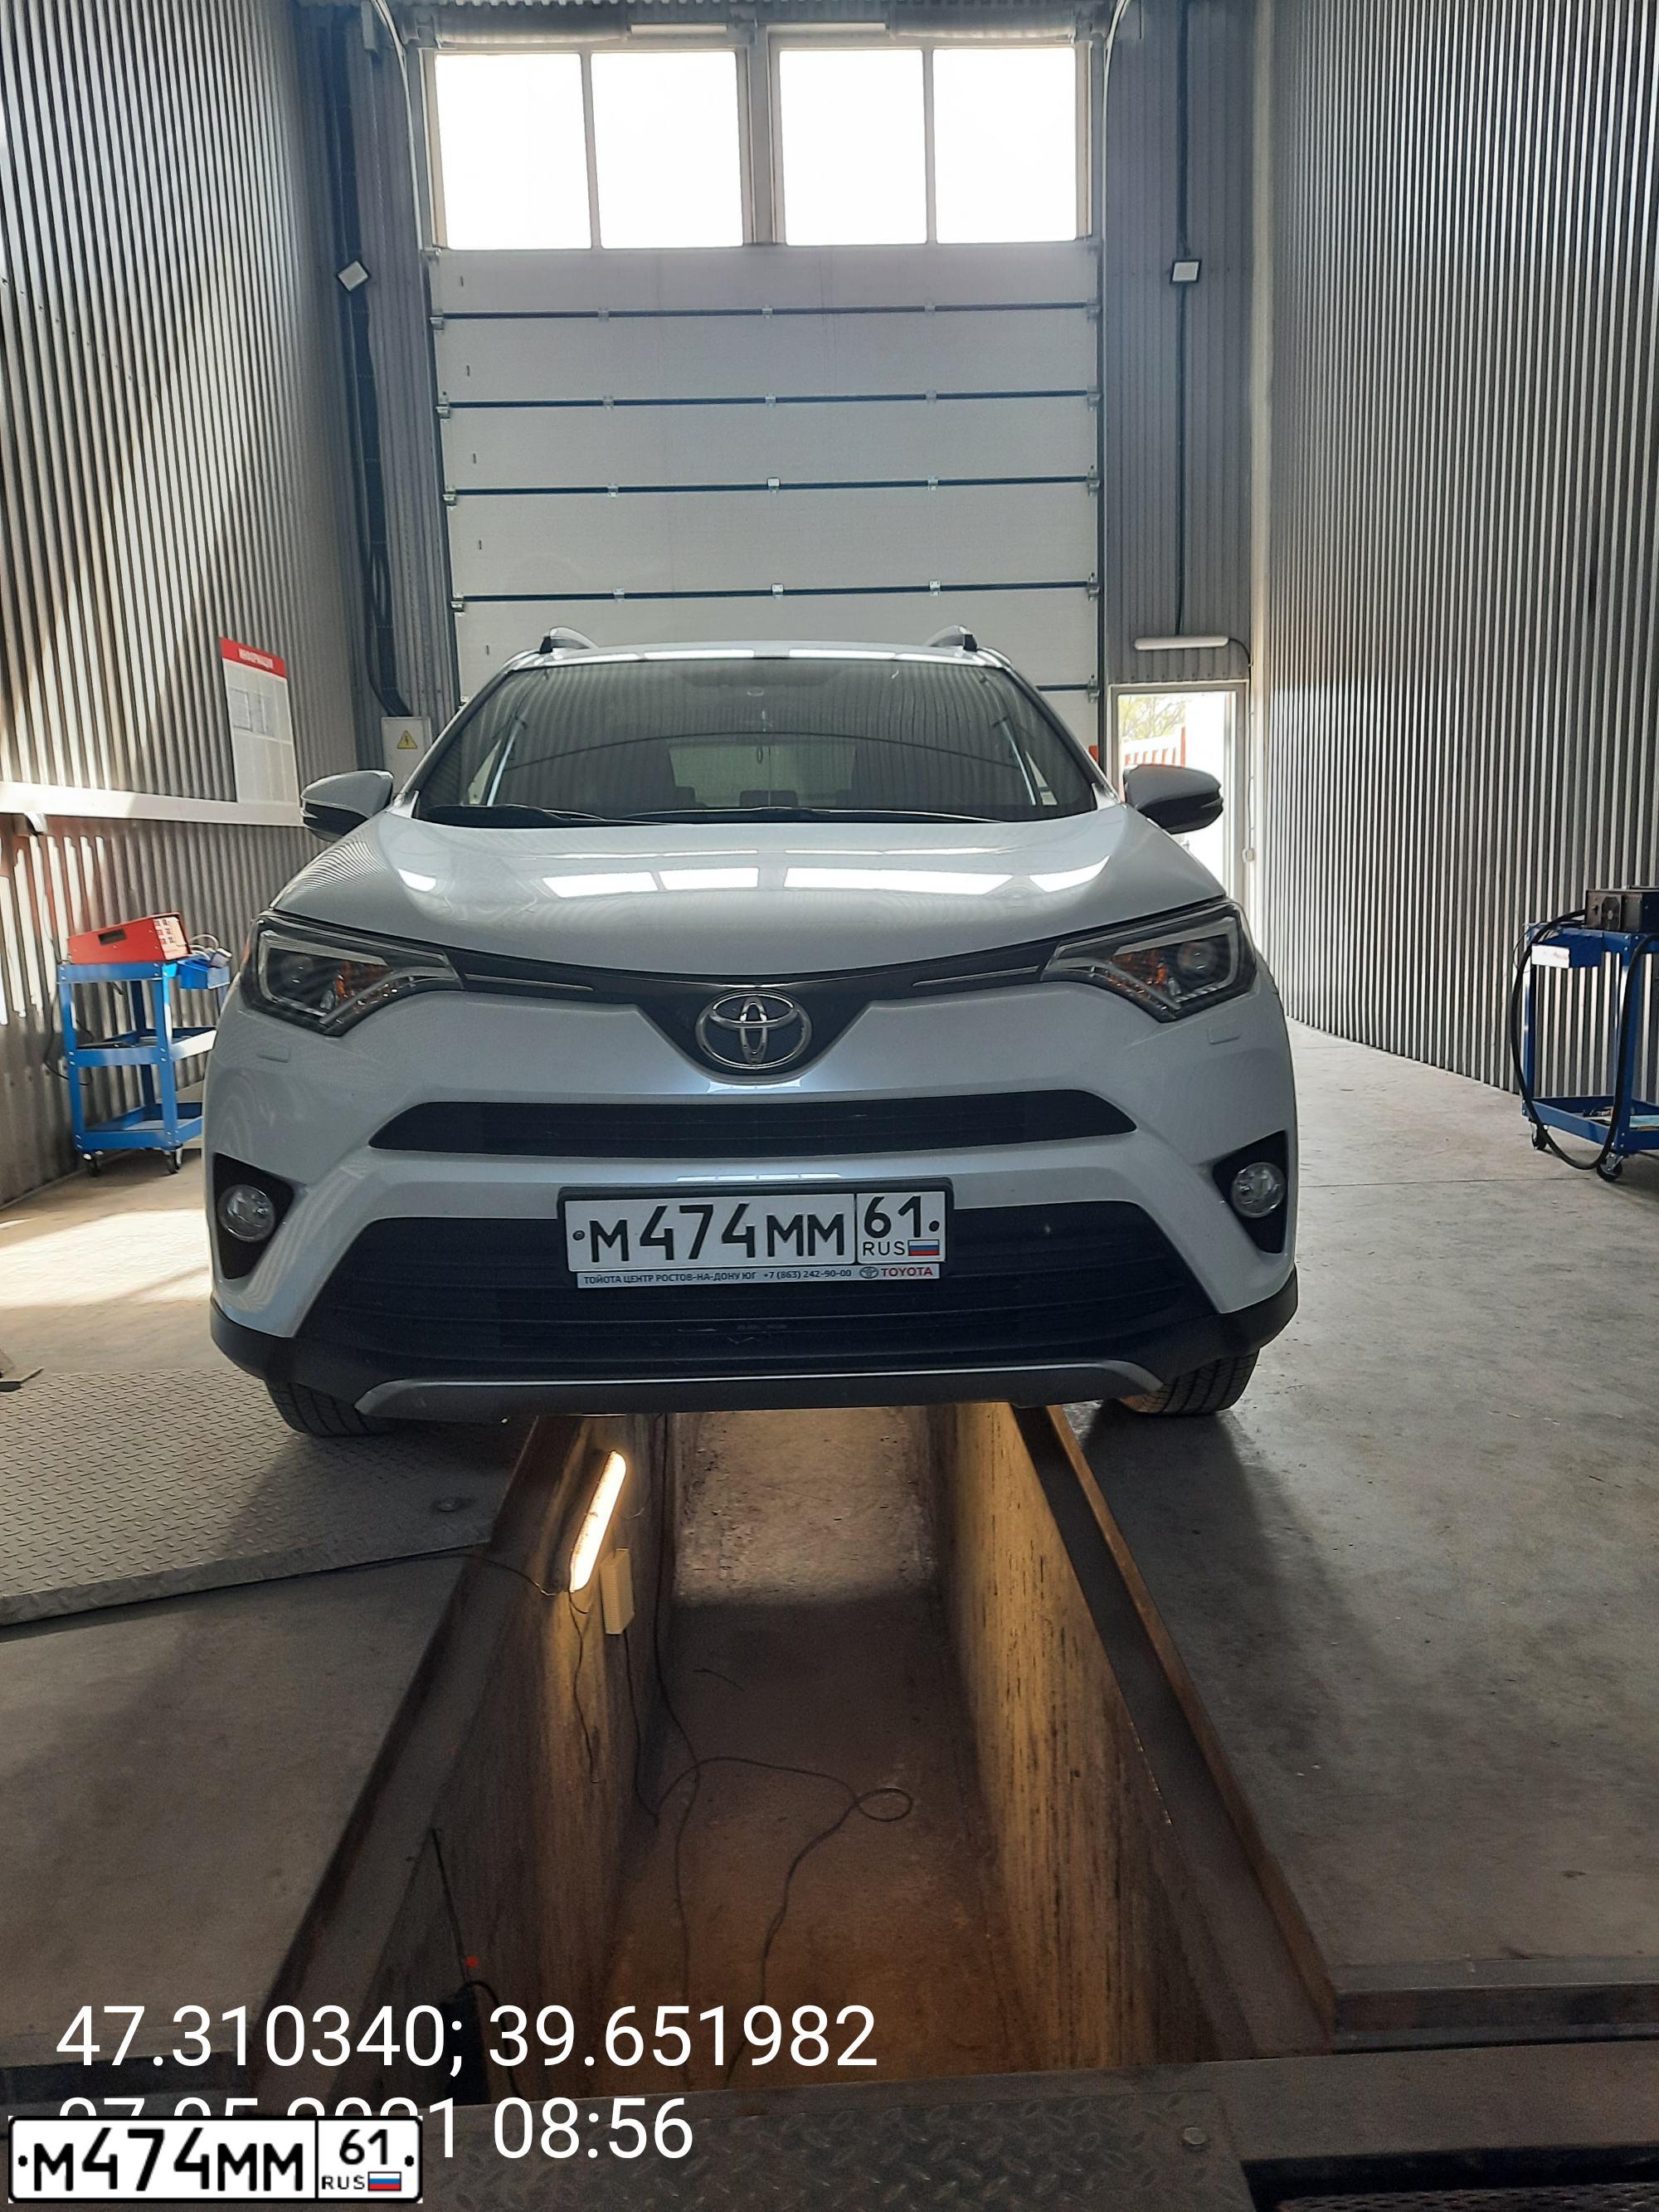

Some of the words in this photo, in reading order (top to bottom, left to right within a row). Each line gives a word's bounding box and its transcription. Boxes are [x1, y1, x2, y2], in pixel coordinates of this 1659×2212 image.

[864, 1196, 922, 1239] 61
[863, 1240, 906, 1257] RUS
[583, 1275, 622, 1284] ТОЙОТА
[624, 1274, 654, 1284] ЦЕНТР
[655, 1272, 741, 1283] РОСТОВ-НА-ДОНУ
[742, 1271, 757, 1281] ЮГ
[763, 1271, 775, 1279] +7
[803, 1269, 852, 1279] 242-90-00
[880, 1266, 934, 1278] TOYOTA
